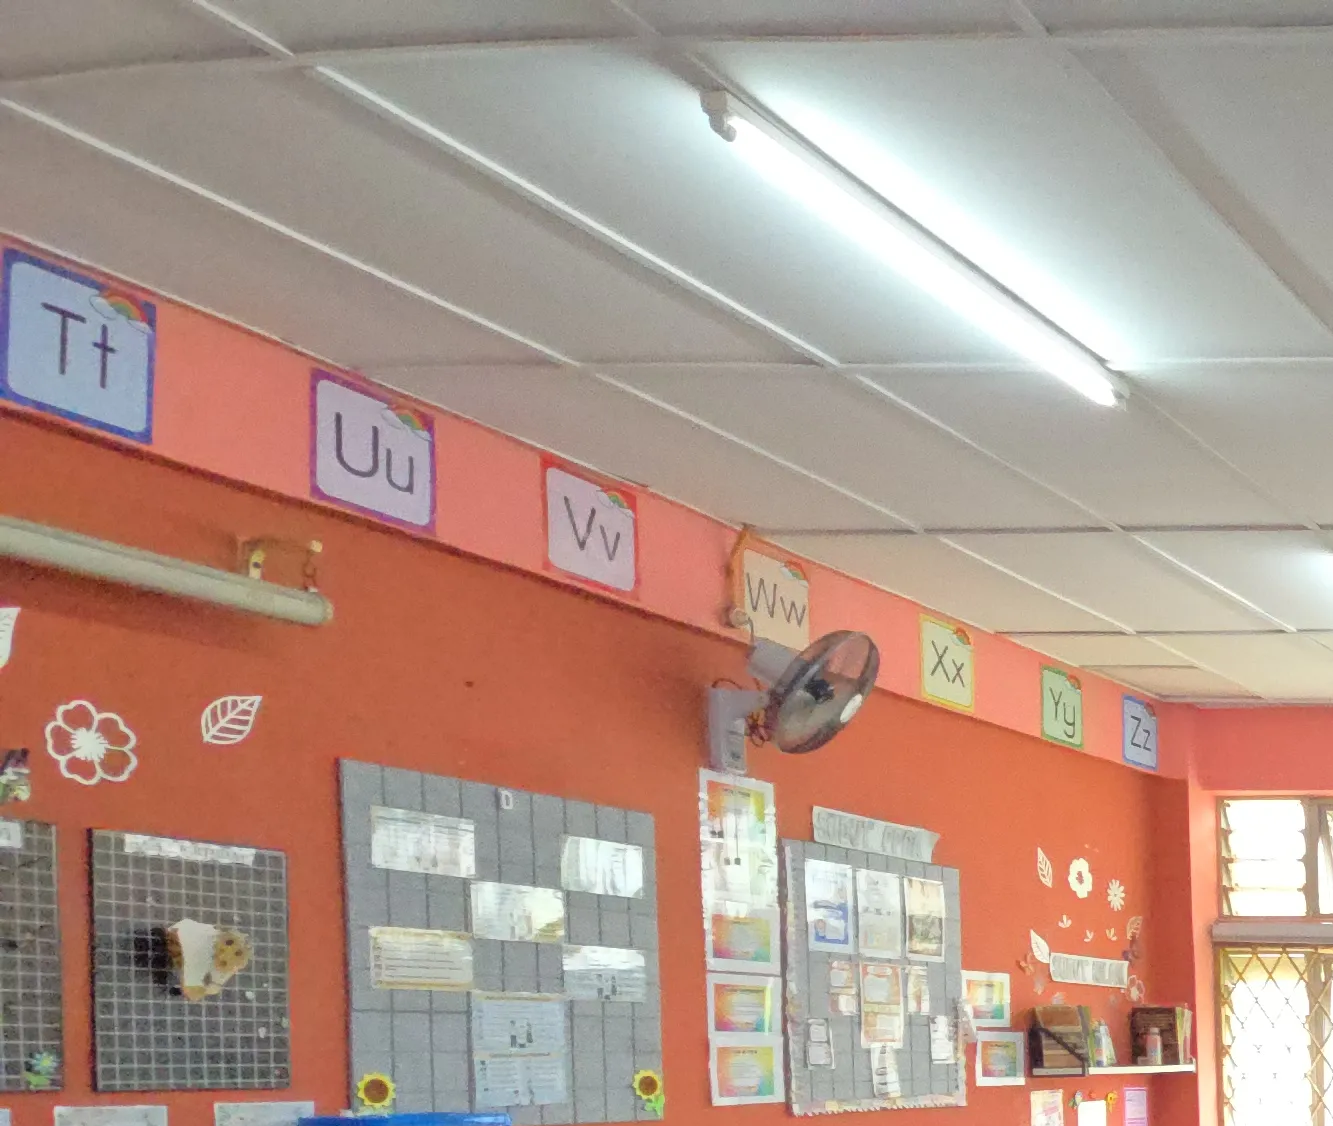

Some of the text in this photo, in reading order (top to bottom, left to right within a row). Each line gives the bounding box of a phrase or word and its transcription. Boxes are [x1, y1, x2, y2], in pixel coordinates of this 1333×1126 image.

[41, 302, 118, 389] Tt
[334, 411, 415, 494] Uu
[562, 495, 621, 562] Vv
[745, 570, 806, 628] Ww
[930, 639, 966, 689] Xx
[1049, 687, 1077, 740] Yy
[1129, 714, 1153, 753] Zz
